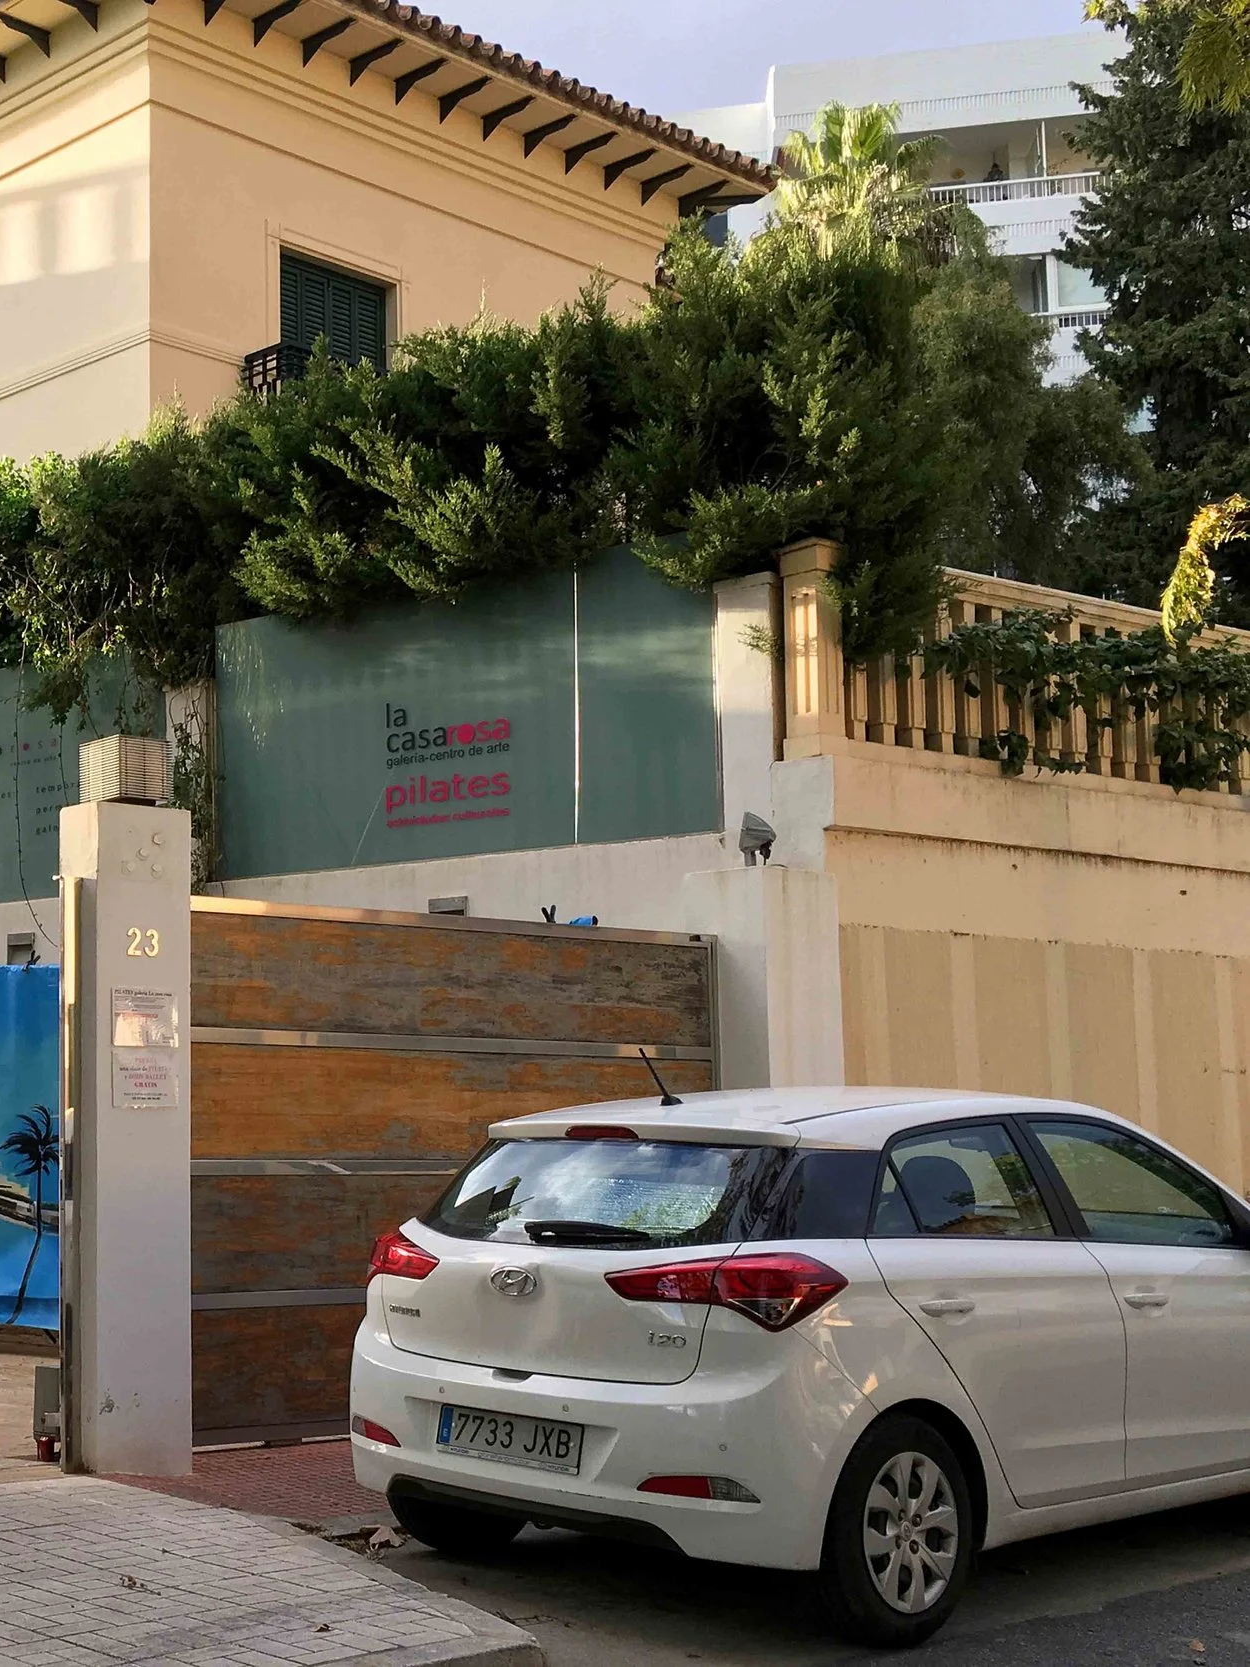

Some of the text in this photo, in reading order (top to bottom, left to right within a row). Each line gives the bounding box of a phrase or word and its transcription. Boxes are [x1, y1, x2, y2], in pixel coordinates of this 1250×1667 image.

[385, 703, 407, 728] la
[386, 717, 511, 753] casarosa
[468, 745, 484, 756] de
[486, 742, 510, 754] arte
[384, 772, 511, 815] pilates
[127, 927, 159, 957] 23
[455, 1413, 514, 1449] 7733
[523, 1424, 571, 1459] JXB
